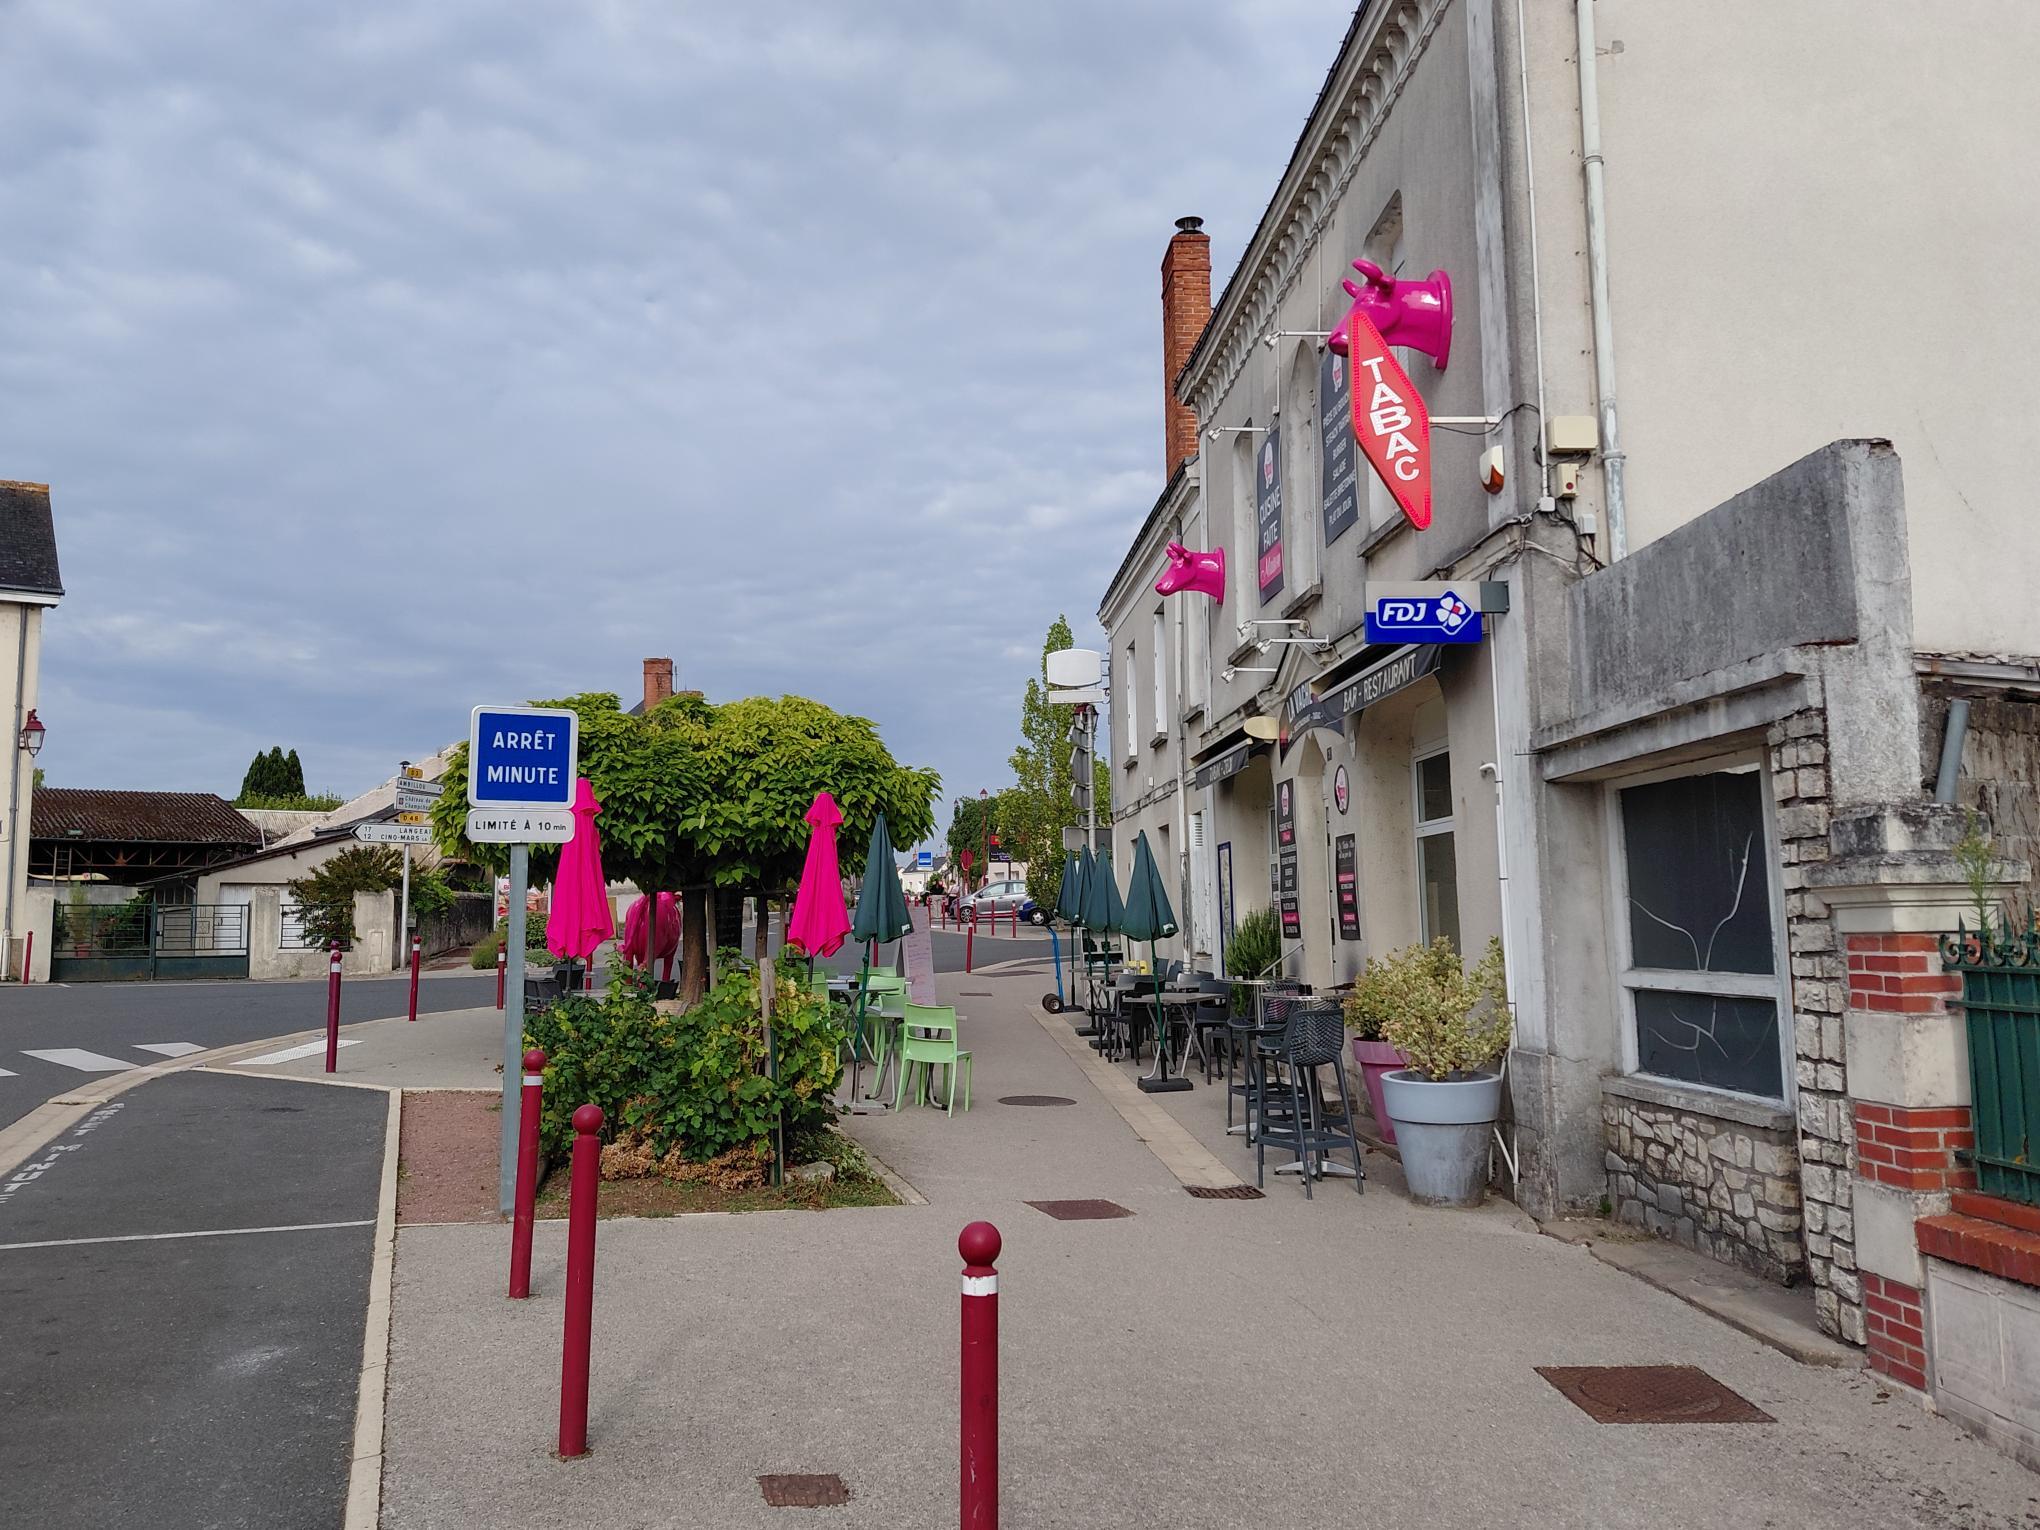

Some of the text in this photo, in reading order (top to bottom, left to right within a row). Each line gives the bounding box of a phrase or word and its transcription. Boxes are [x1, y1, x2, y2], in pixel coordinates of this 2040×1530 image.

[1362, 356, 1420, 481] TABAC
[1259, 485, 1280, 525] CUISINE
[1263, 520, 1278, 553] FAITE
[1382, 603, 1427, 622] FDJ
[1343, 685, 1357, 713] BAR
[1363, 653, 1417, 703] RESTAURANT
[1286, 697, 1296, 723] LA
[492, 730, 556, 751] ARRÊT
[399, 780, 426, 790] AMBILLOU
[487, 765, 559, 785] MINUTE
[400, 827, 432, 835] LANGEAI
[475, 819, 517, 830] LIMITÉ
[524, 819, 531, 830] À
[538, 822, 552, 831] 10
[380, 834, 420, 842] CINQ-MARS
